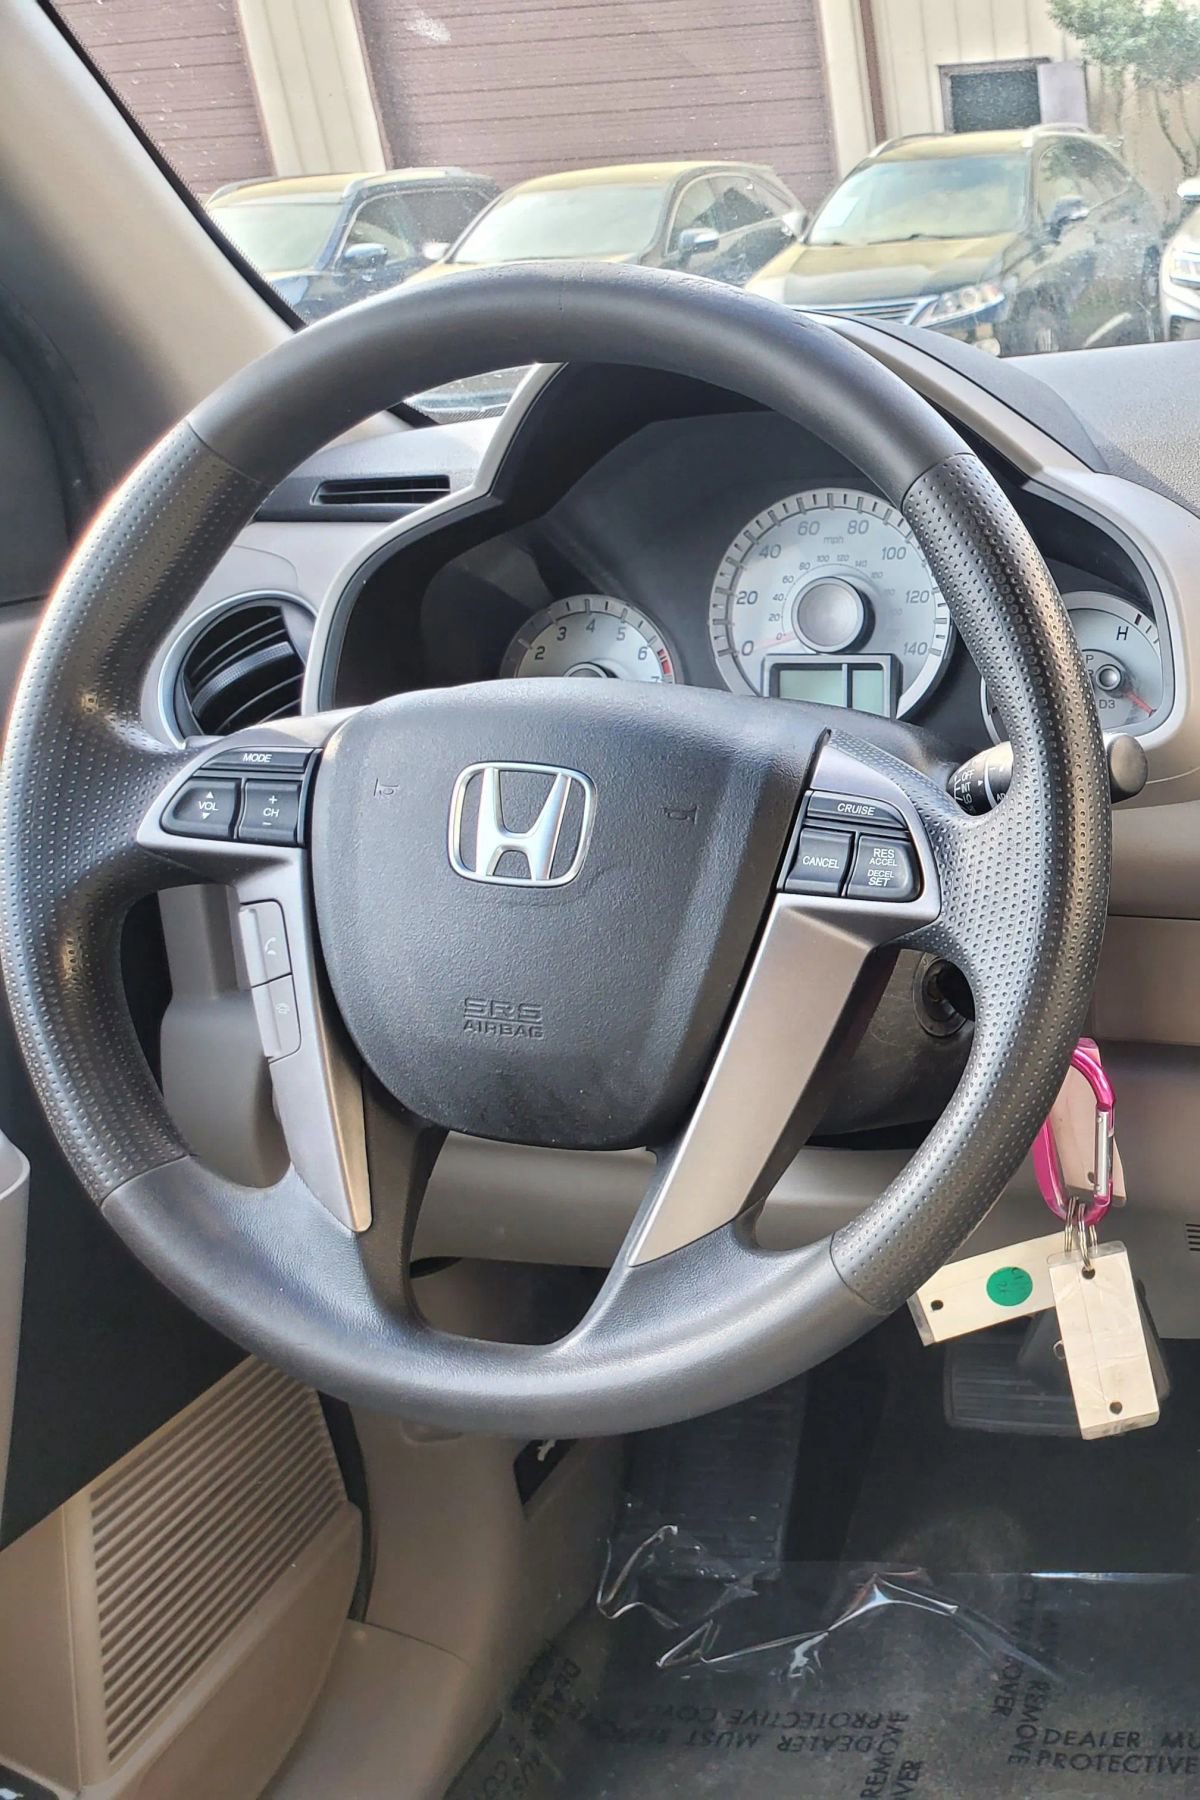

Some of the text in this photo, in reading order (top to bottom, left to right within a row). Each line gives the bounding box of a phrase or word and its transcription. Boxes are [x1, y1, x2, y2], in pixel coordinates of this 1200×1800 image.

[797, 521, 820, 536] 60
[847, 520, 869, 534] 80
[824, 535, 844, 545] mph
[759, 544, 782, 559] 40
[882, 546, 907, 560] 100
[782, 575, 794, 584] 60
[736, 590, 759, 605] 20
[772, 593, 784, 601] 40
[905, 590, 930, 604] 120
[768, 613, 781, 622] 20
[586, 618, 596, 633] 4
[556, 626, 567, 642] 3
[616, 626, 626, 642] 5
[1116, 626, 1130, 641] H
[534, 646, 545, 660] 2
[637, 646, 648, 661] 6
[741, 640, 755, 656] 0
[904, 642, 928, 655] 140
[1085, 655, 1095, 664] P
[243, 752, 273, 763] MODE
[198, 801, 219, 812] VOL
[263, 808, 280, 818] CH
[837, 802, 876, 816] CRUISE
[873, 848, 895, 859] RES
[802, 855, 840, 868] CANCEL
[869, 858, 897, 867] ACCEL
[867, 869, 895, 878] DECEL
[868, 877, 890, 887] SET
[464, 998, 543, 1021] SRS
[463, 1019, 544, 1040] AIRBAG
[727, 1709, 882, 1729] PROTECTIVE
[777, 1734, 875, 1752] DEALER
[1043, 1728, 1141, 1748] DEALER
[1036, 1750, 1198, 1775] PROTECTIVE
